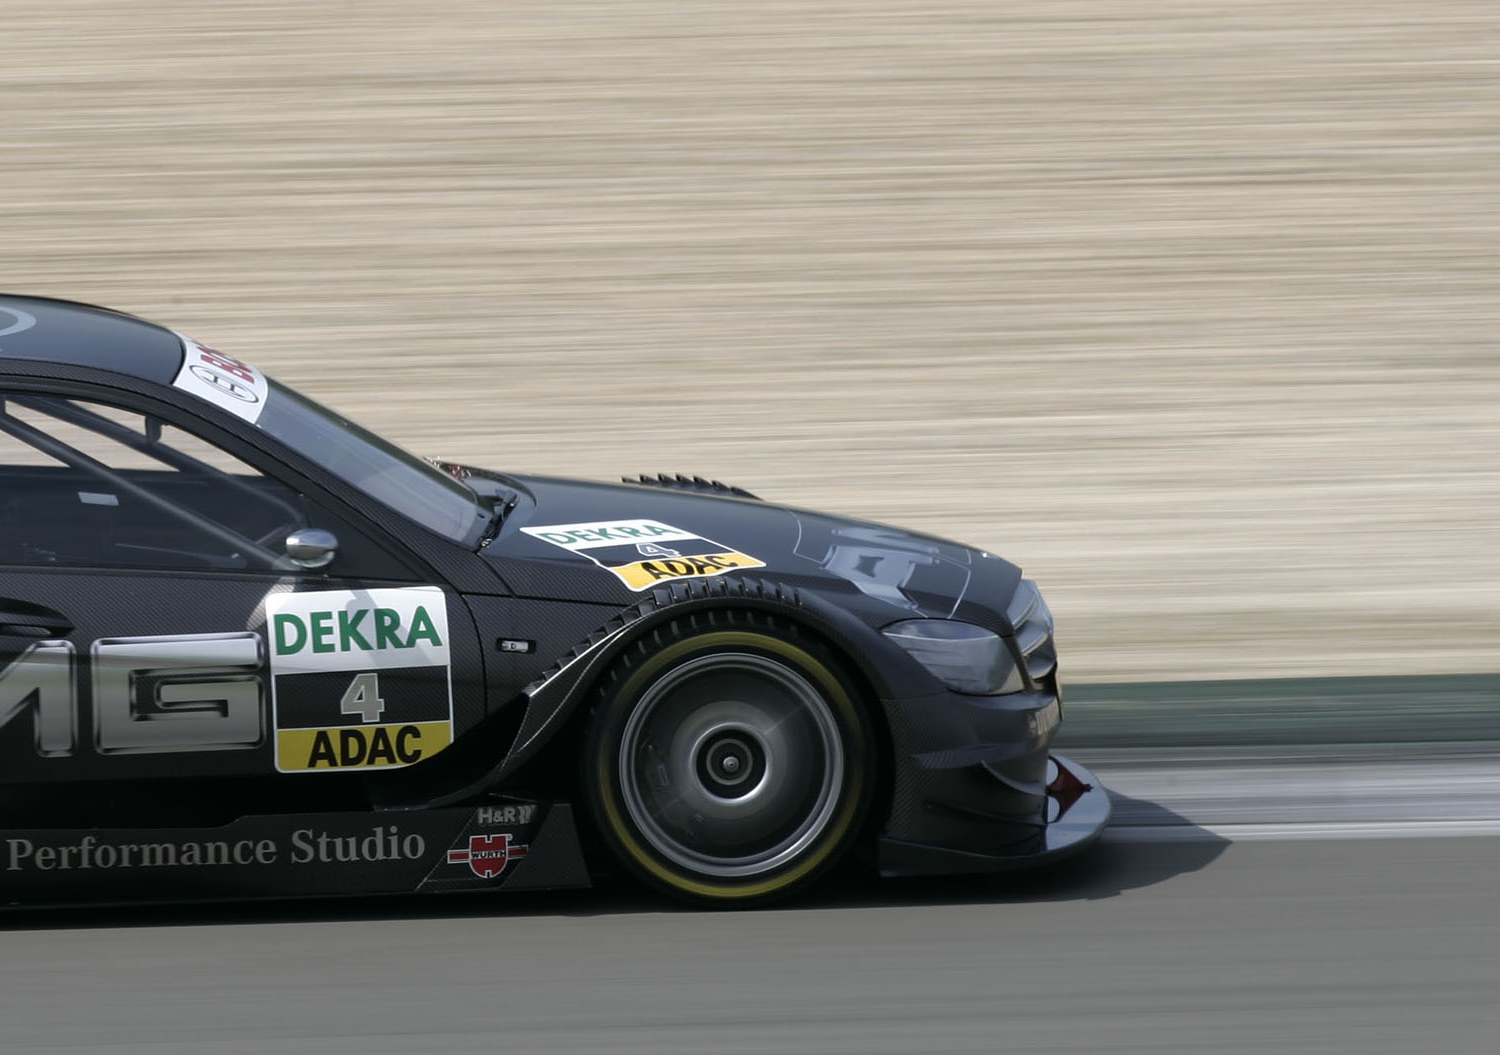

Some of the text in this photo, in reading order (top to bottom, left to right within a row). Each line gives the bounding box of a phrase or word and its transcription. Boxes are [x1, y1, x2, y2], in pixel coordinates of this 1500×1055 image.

[537, 524, 681, 545] DEKRA
[635, 542, 681, 558] 4
[641, 555, 739, 580] ADAC
[273, 605, 443, 656] DEKRA
[340, 672, 385, 723] 4
[307, 725, 422, 768] ADAC
[477, 806, 516, 824] H&R
[6, 825, 427, 871] Performance Studio
